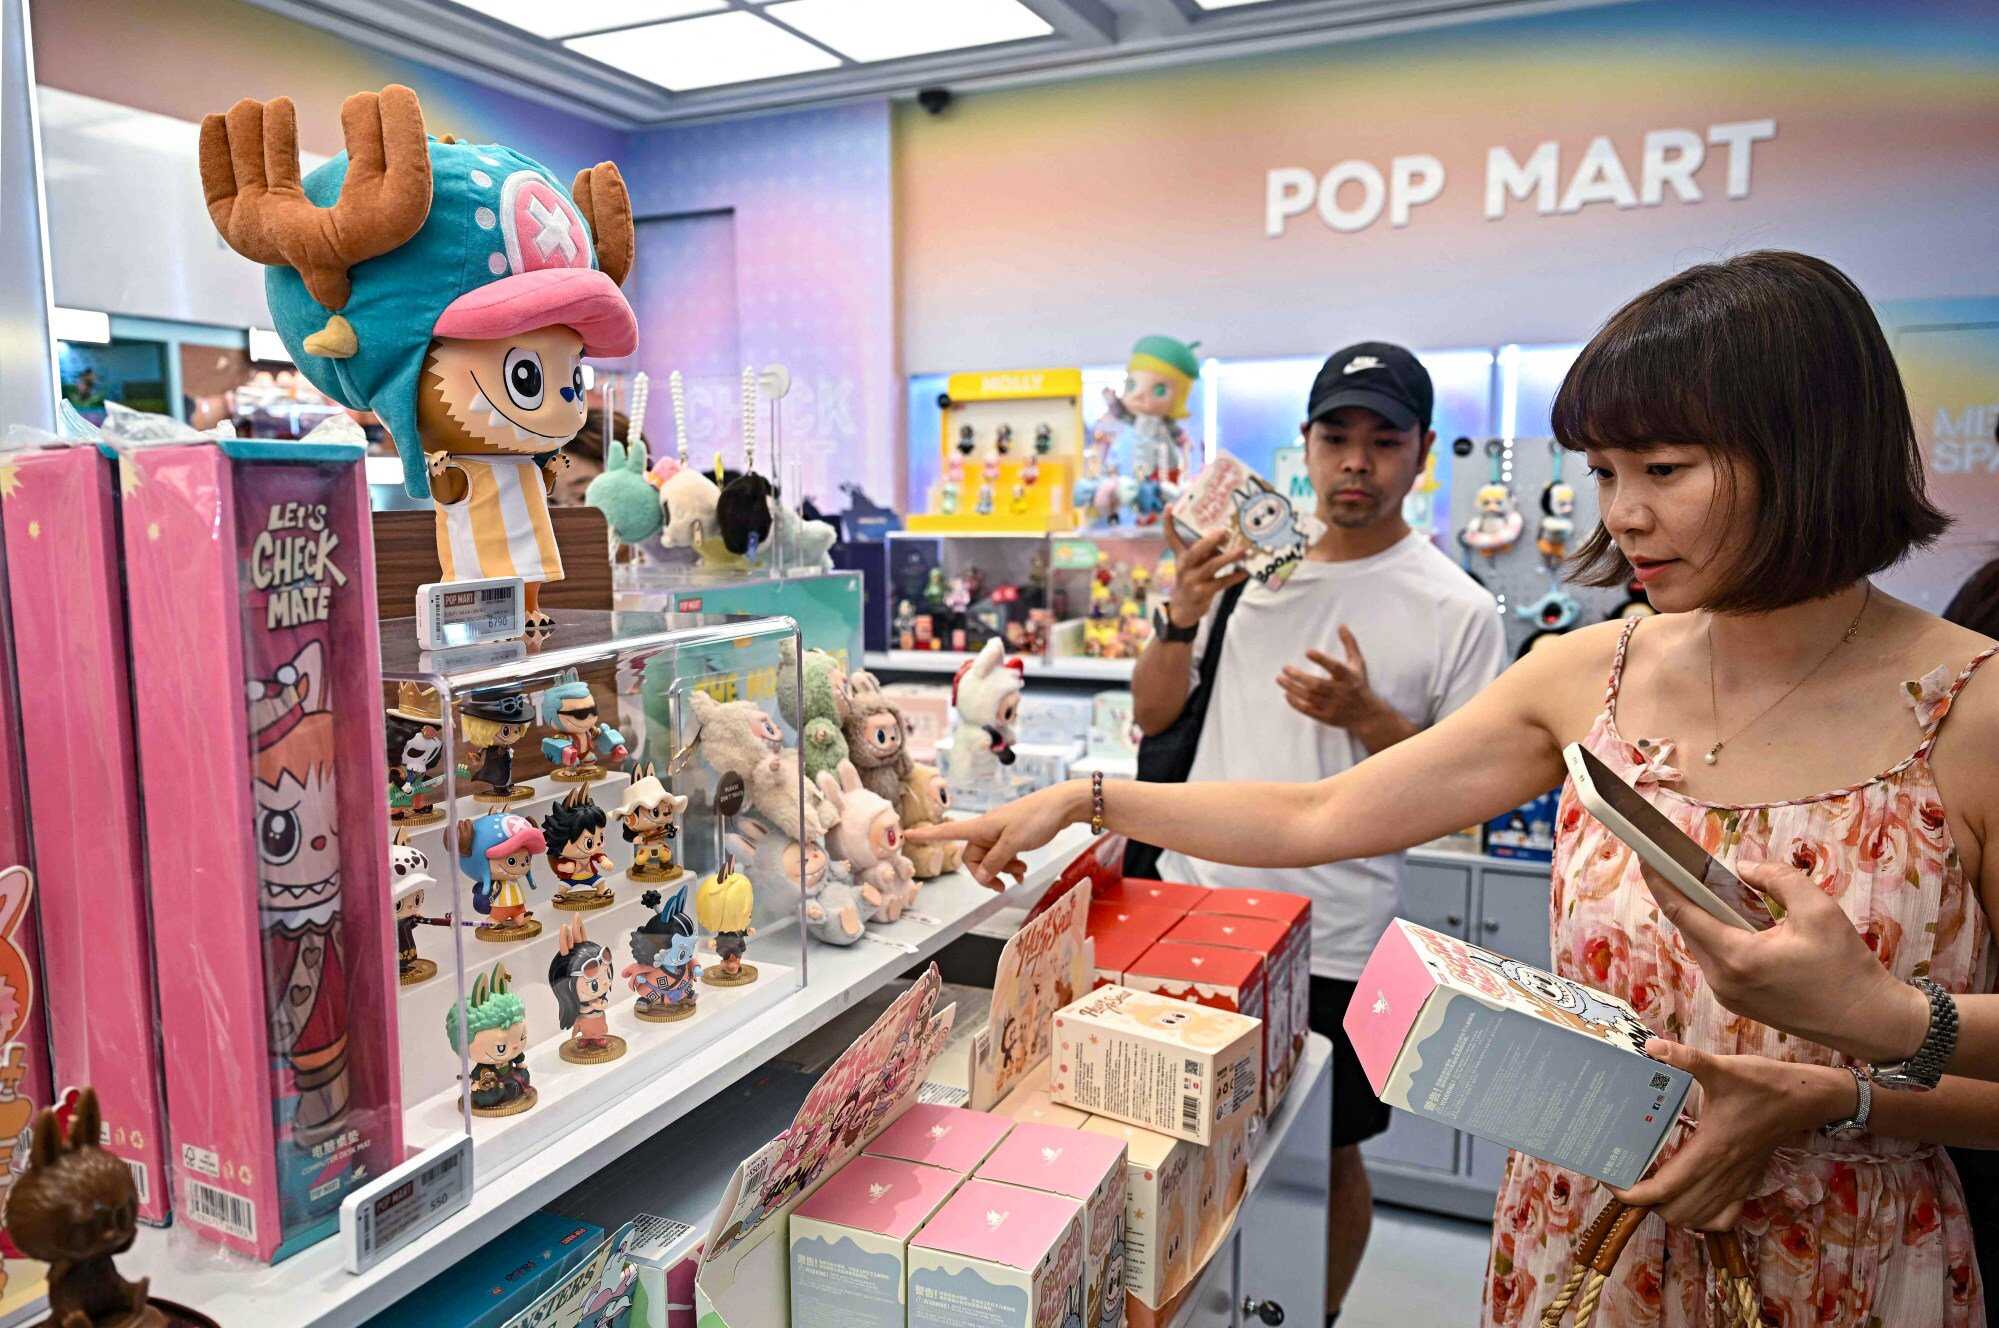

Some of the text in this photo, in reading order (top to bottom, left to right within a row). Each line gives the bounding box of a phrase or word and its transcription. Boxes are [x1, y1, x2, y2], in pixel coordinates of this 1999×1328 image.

[1266, 119, 1776, 238] POP MART
[267, 502, 328, 531] LET'S
[252, 528, 347, 590] CHECK
[267, 587, 332, 629] MATE
[445, 592, 474, 606] POP MART
